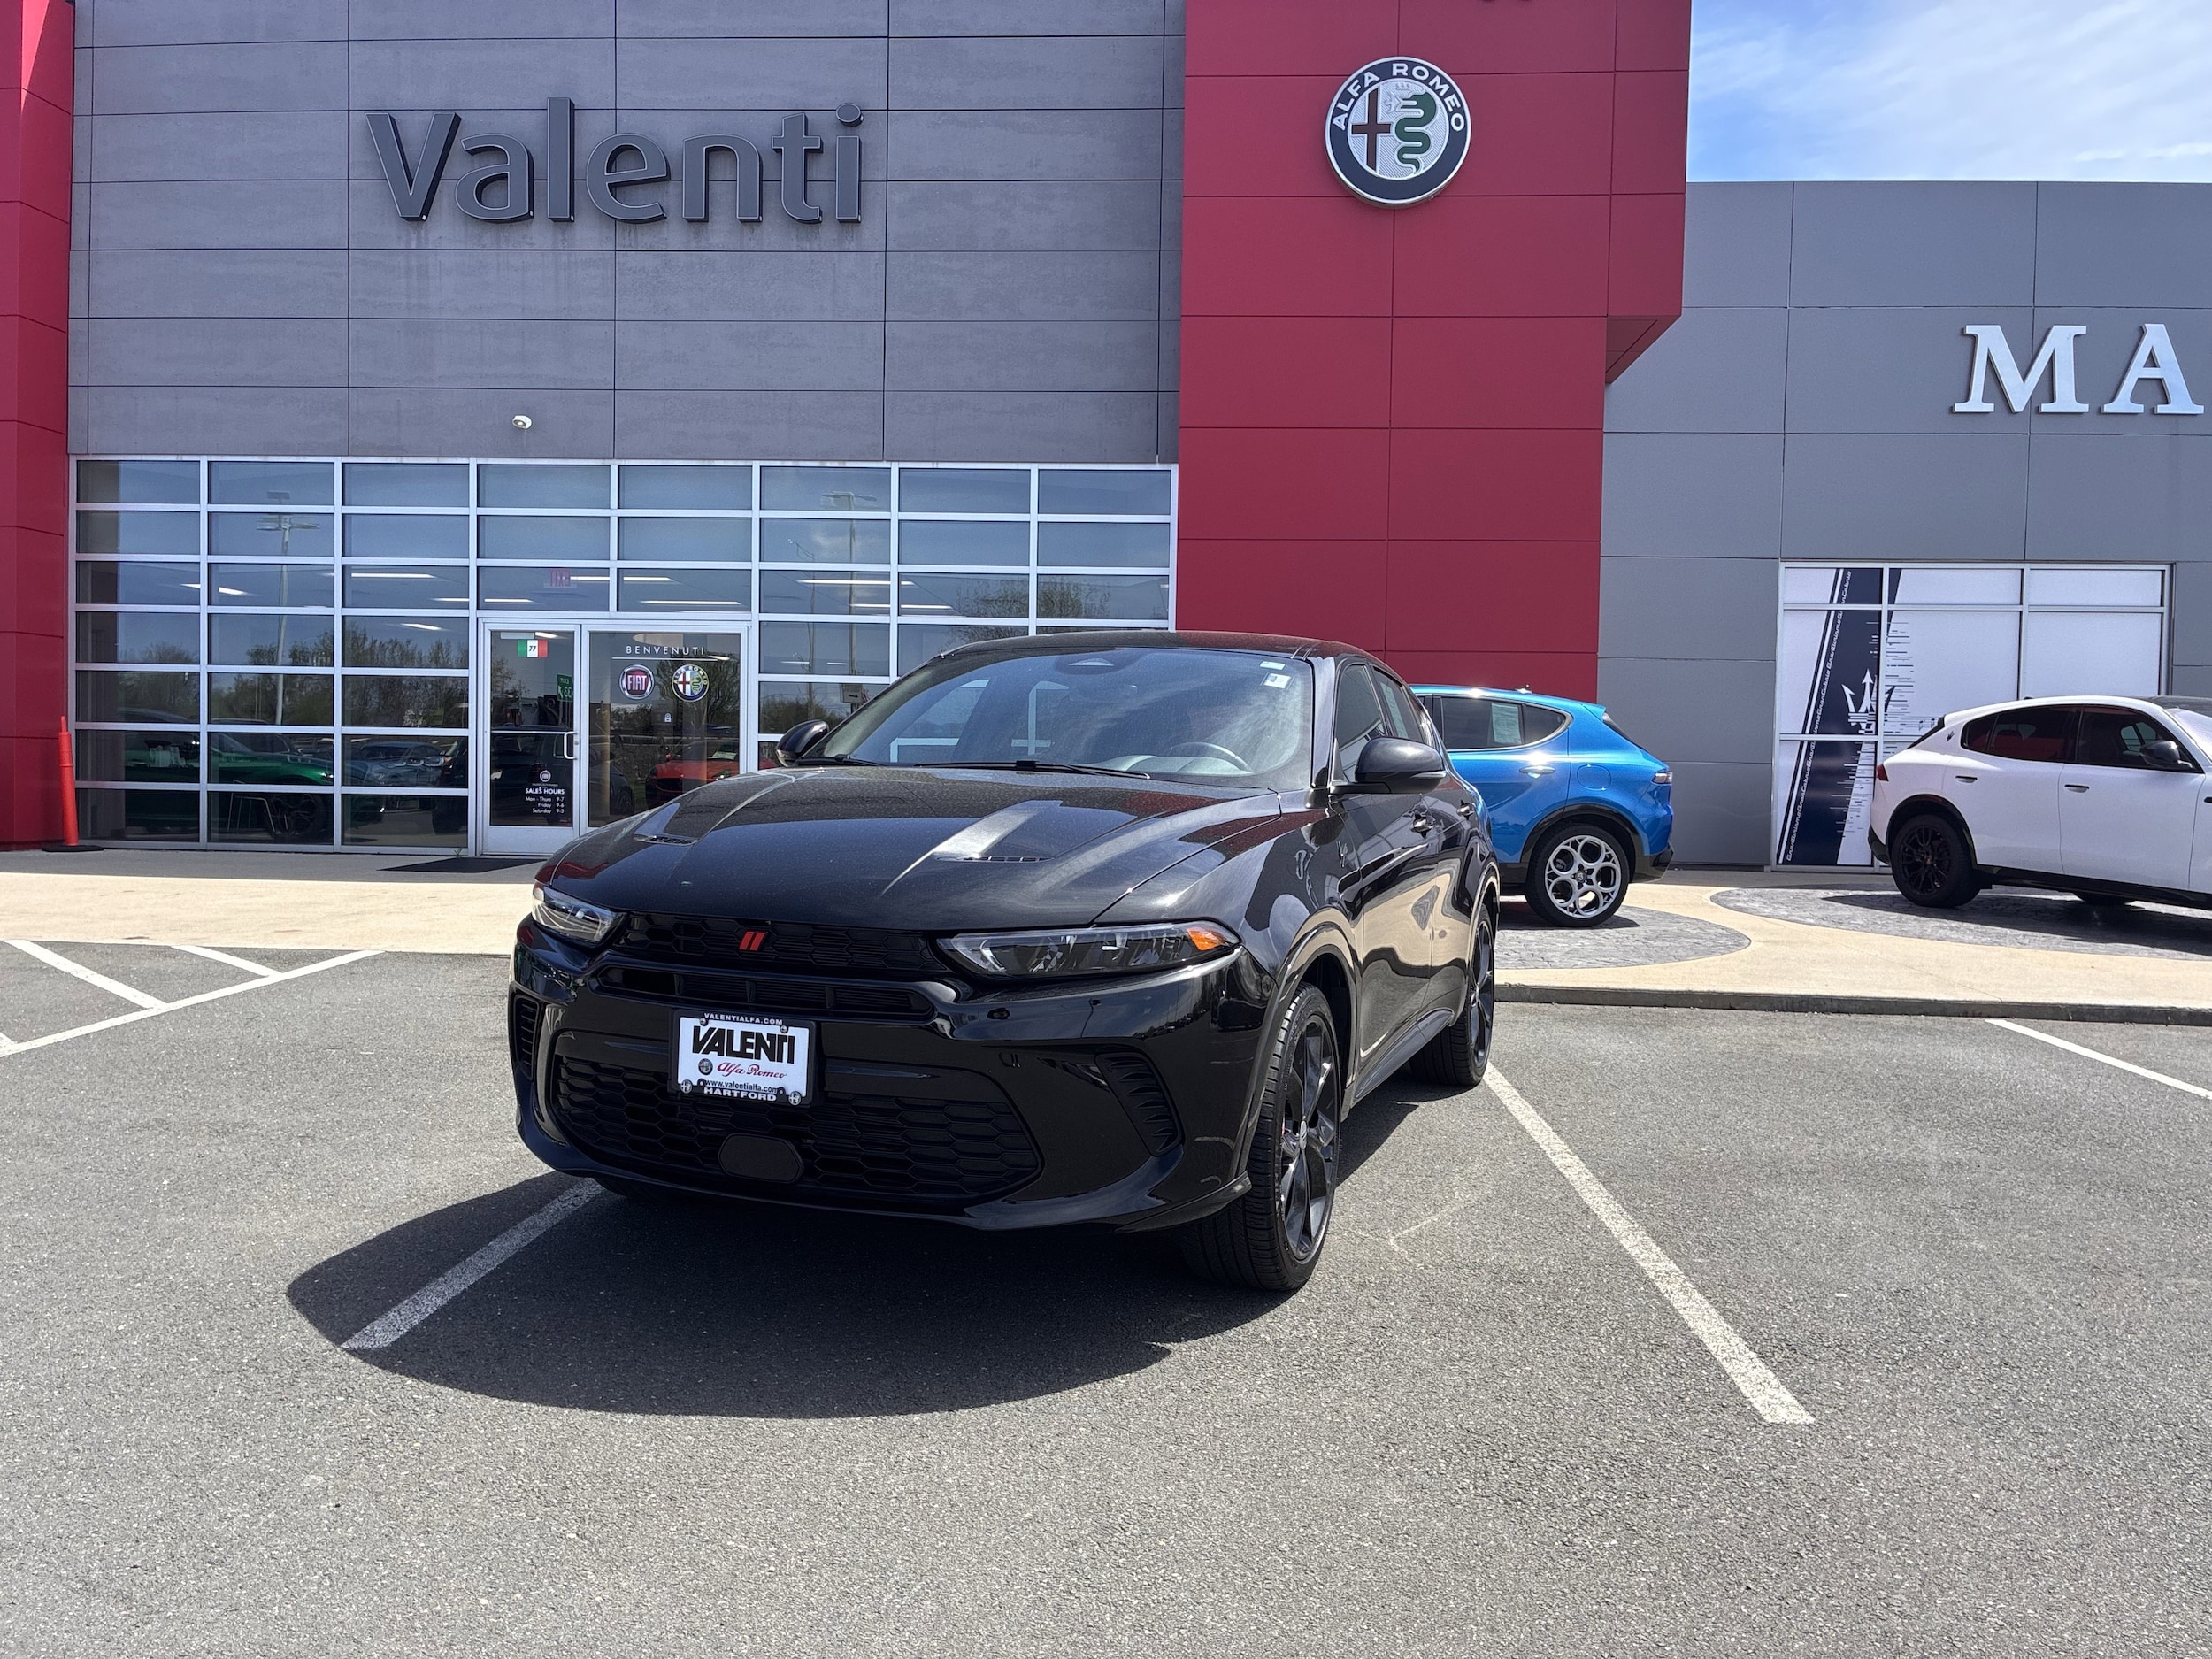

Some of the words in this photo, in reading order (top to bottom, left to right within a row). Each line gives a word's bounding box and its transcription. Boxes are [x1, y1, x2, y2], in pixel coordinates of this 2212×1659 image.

[1332, 71, 1380, 131] ALFA
[1392, 63, 1465, 132] ROMEO
[365, 97, 864, 223] Valenti
[1953, 323, 2205, 415] MA
[626, 645, 705, 656] BENVENUTI
[627, 674, 648, 691] FIAT
[703, 1012, 784, 1025] VALENTIALFA.COM
[692, 1025, 795, 1064] VALENTI
[717, 1062, 747, 1077] Alfa
[746, 1064, 787, 1079] Romeo
[703, 1087, 778, 1102] HARTFORD
[706, 1079, 779, 1094] www.valentialfa.com
